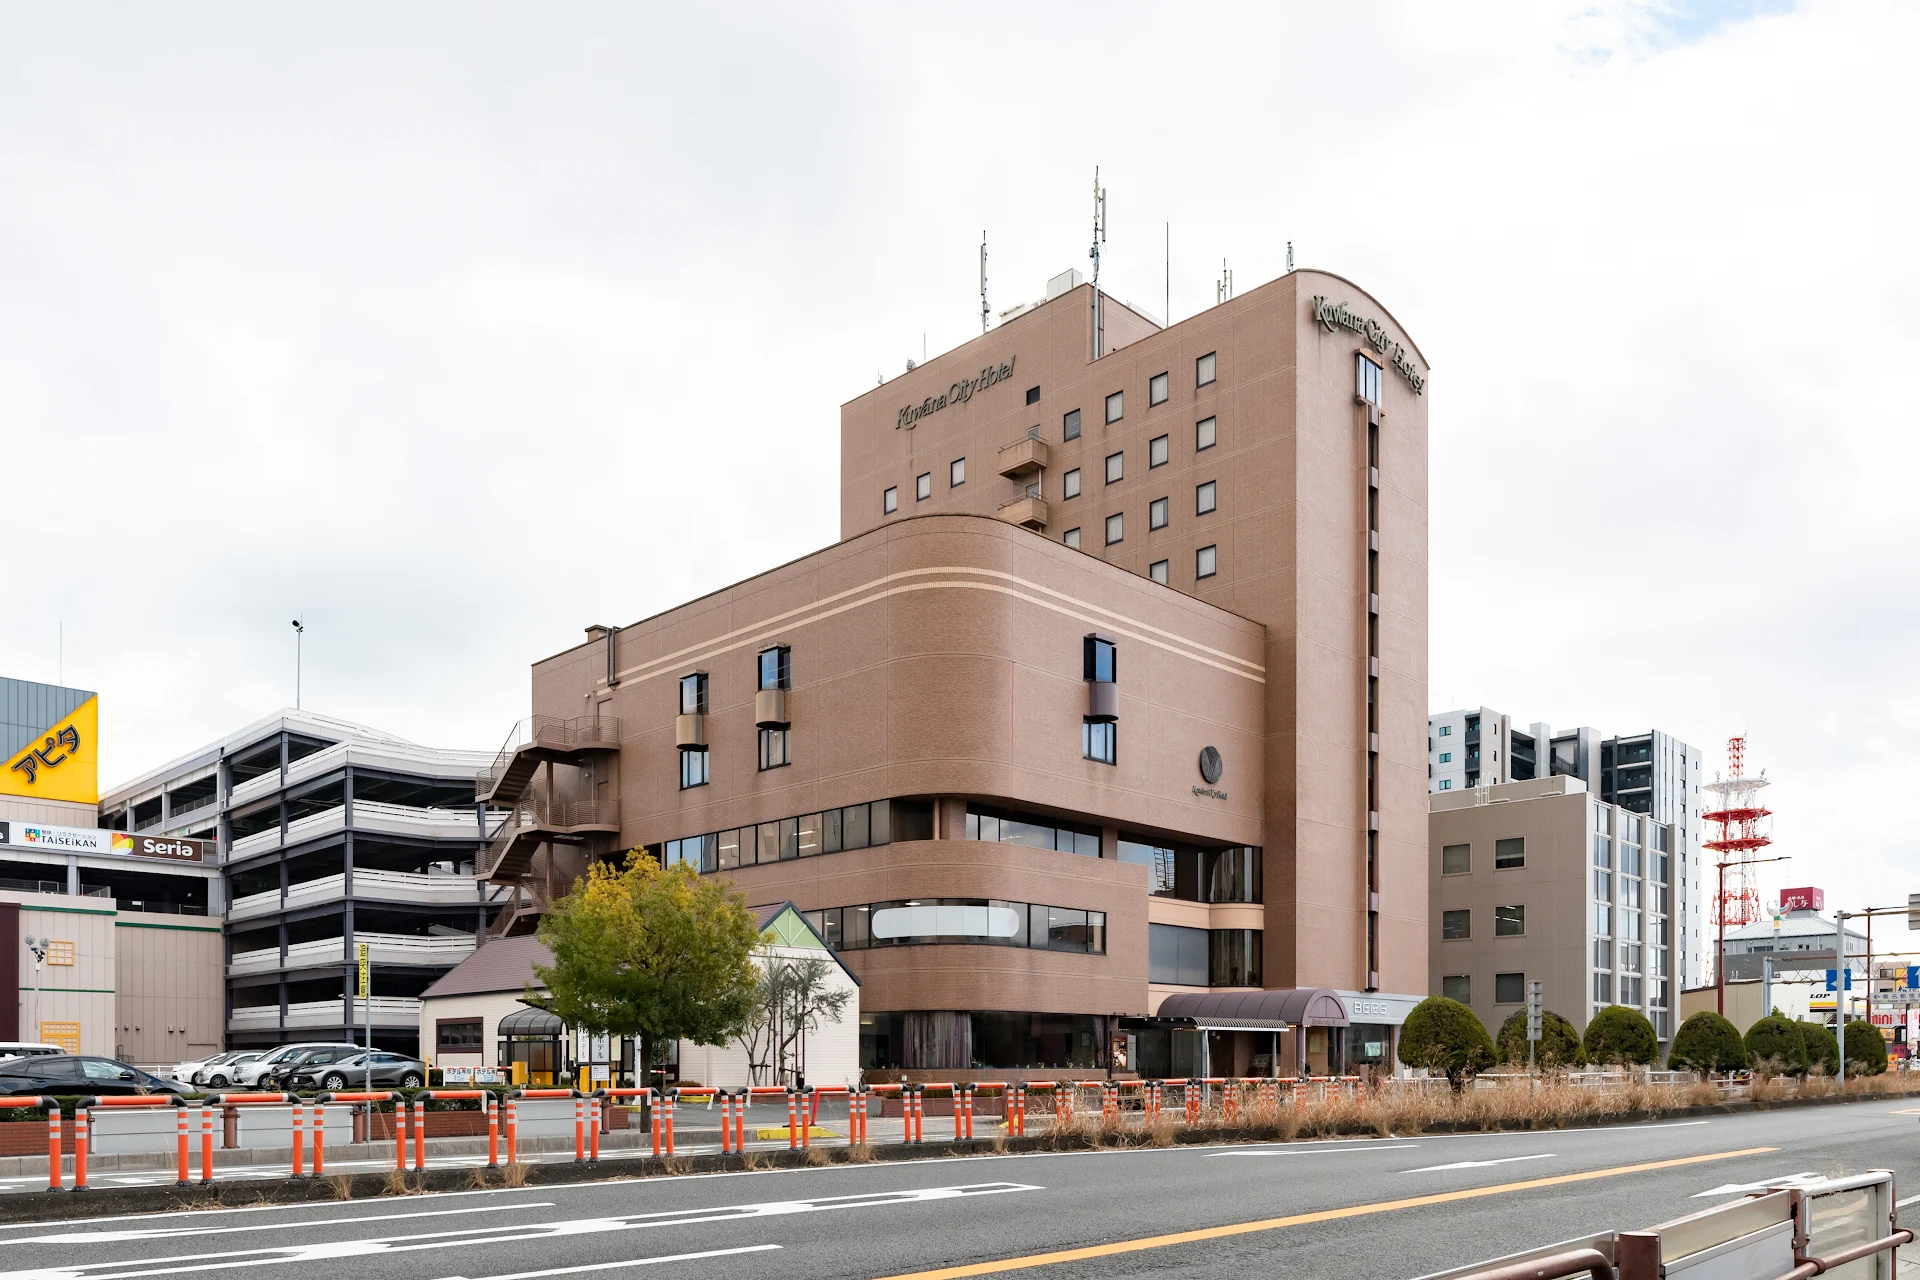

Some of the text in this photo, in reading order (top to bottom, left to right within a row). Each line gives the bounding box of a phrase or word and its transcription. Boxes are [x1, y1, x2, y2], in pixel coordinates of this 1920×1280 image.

[1313, 295, 1425, 396] Kuwana City Hotel
[895, 355, 1016, 431] Kuwana City Hotel
[12, 724, 80, 784] アピタ
[143, 839, 193, 857] Seria
[1354, 1001, 1387, 1015] BERG
